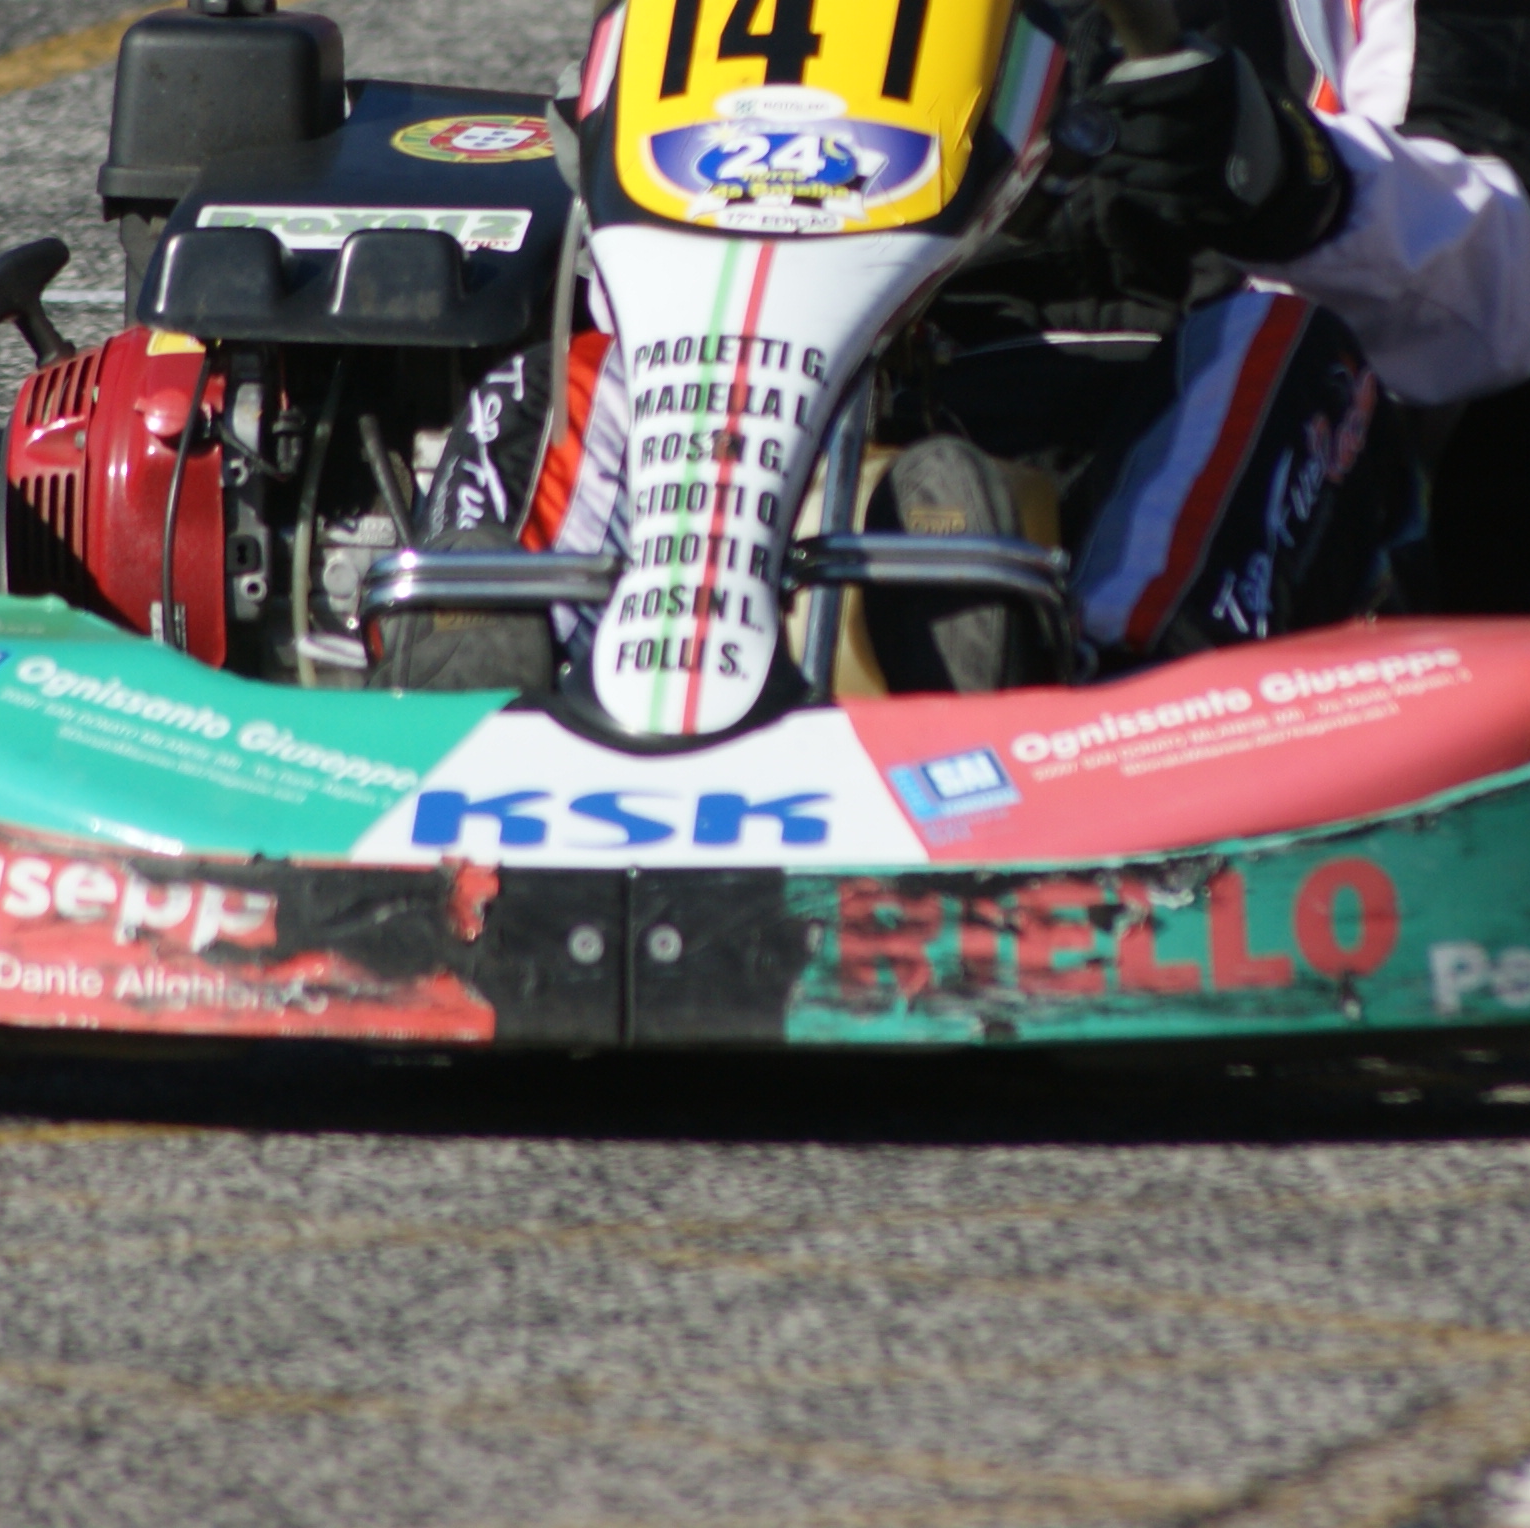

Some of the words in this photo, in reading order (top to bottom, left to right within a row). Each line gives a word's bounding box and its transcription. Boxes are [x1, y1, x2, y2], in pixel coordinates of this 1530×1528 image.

[718, 133, 828, 180] 24
[633, 335, 790, 380] PAOLETTI
[802, 346, 830, 389] G.
[634, 382, 784, 423] MADELLA
[618, 584, 729, 626] ROSIN
[740, 594, 765, 634] L.
[718, 643, 749, 680] S.
[16, 655, 231, 739] Ognissanto
[237, 720, 419, 791] Giuseppe
[1011, 685, 1252, 764] Ognissanto
[1259, 647, 1461, 704] Giuseppe
[411, 790, 835, 848] KSK
[838, 855, 1400, 999] RIELLO
